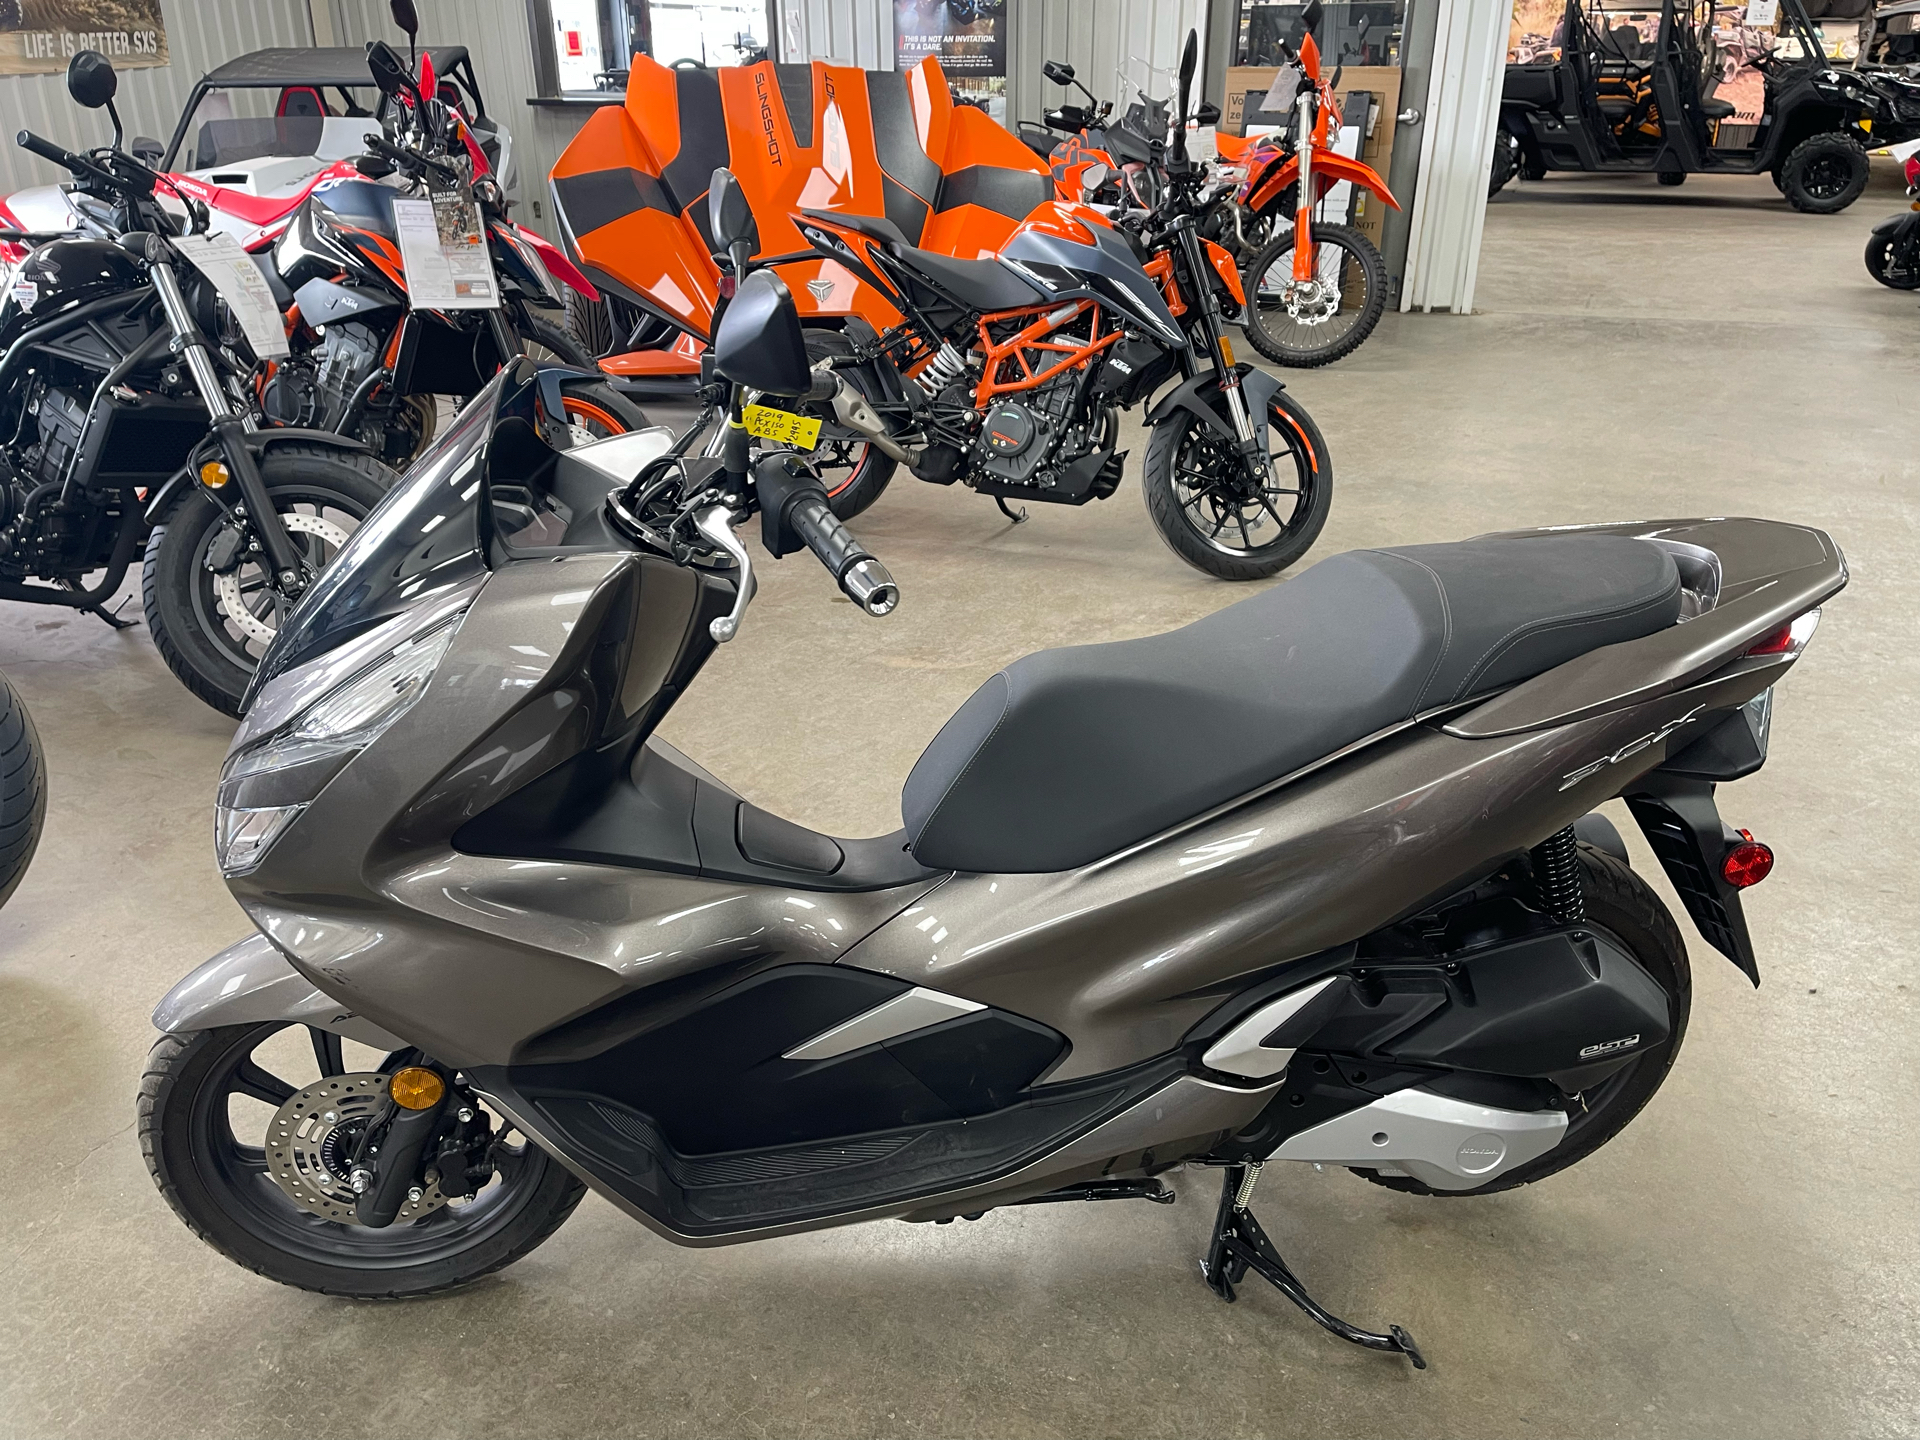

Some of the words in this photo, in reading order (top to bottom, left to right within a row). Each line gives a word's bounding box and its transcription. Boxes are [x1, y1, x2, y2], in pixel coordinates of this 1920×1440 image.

[24, 33, 55, 58] LIFE
[61, 32, 76, 57] IS
[79, 31, 129, 55] BETTER
[133, 30, 157, 54] SXS
[755, 72, 782, 167] SLINGSHOT
[179, 179, 208, 197] HONDA
[433, 196, 463, 204] ADVENTURE
[1355, 221, 1376, 230] NOT
[341, 296, 359, 310] KTM
[1109, 358, 1133, 375] KTM
[757, 409, 784, 422] 2019
[753, 426, 779, 436] ABS
[784, 420, 802, 442] $2995
[1558, 703, 1706, 792] PCX
